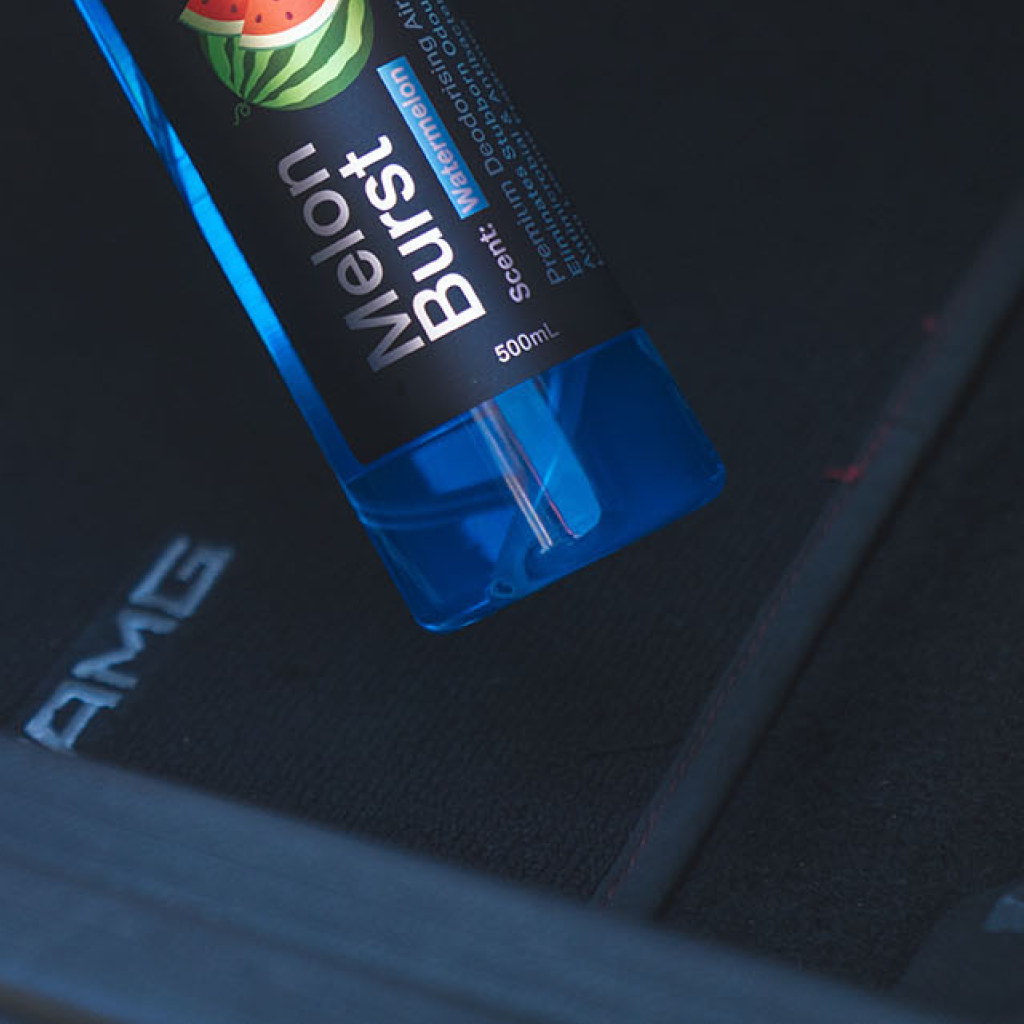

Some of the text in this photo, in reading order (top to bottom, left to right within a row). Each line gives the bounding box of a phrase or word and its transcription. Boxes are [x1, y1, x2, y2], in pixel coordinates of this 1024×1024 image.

[396, 0, 423, 29] Air
[418, 35, 504, 176] Deodorising
[457, 62, 517, 160] Stubborn
[338, 135, 486, 342] Burst
[391, 68, 530, 303] Scent: Watermelon
[500, 179, 566, 285] Premium
[516, 165, 583, 277] Eliminates
[276, 143, 425, 372] Melon
[494, 322, 560, 363] 500mL
[23, 535, 233, 750] AMG
